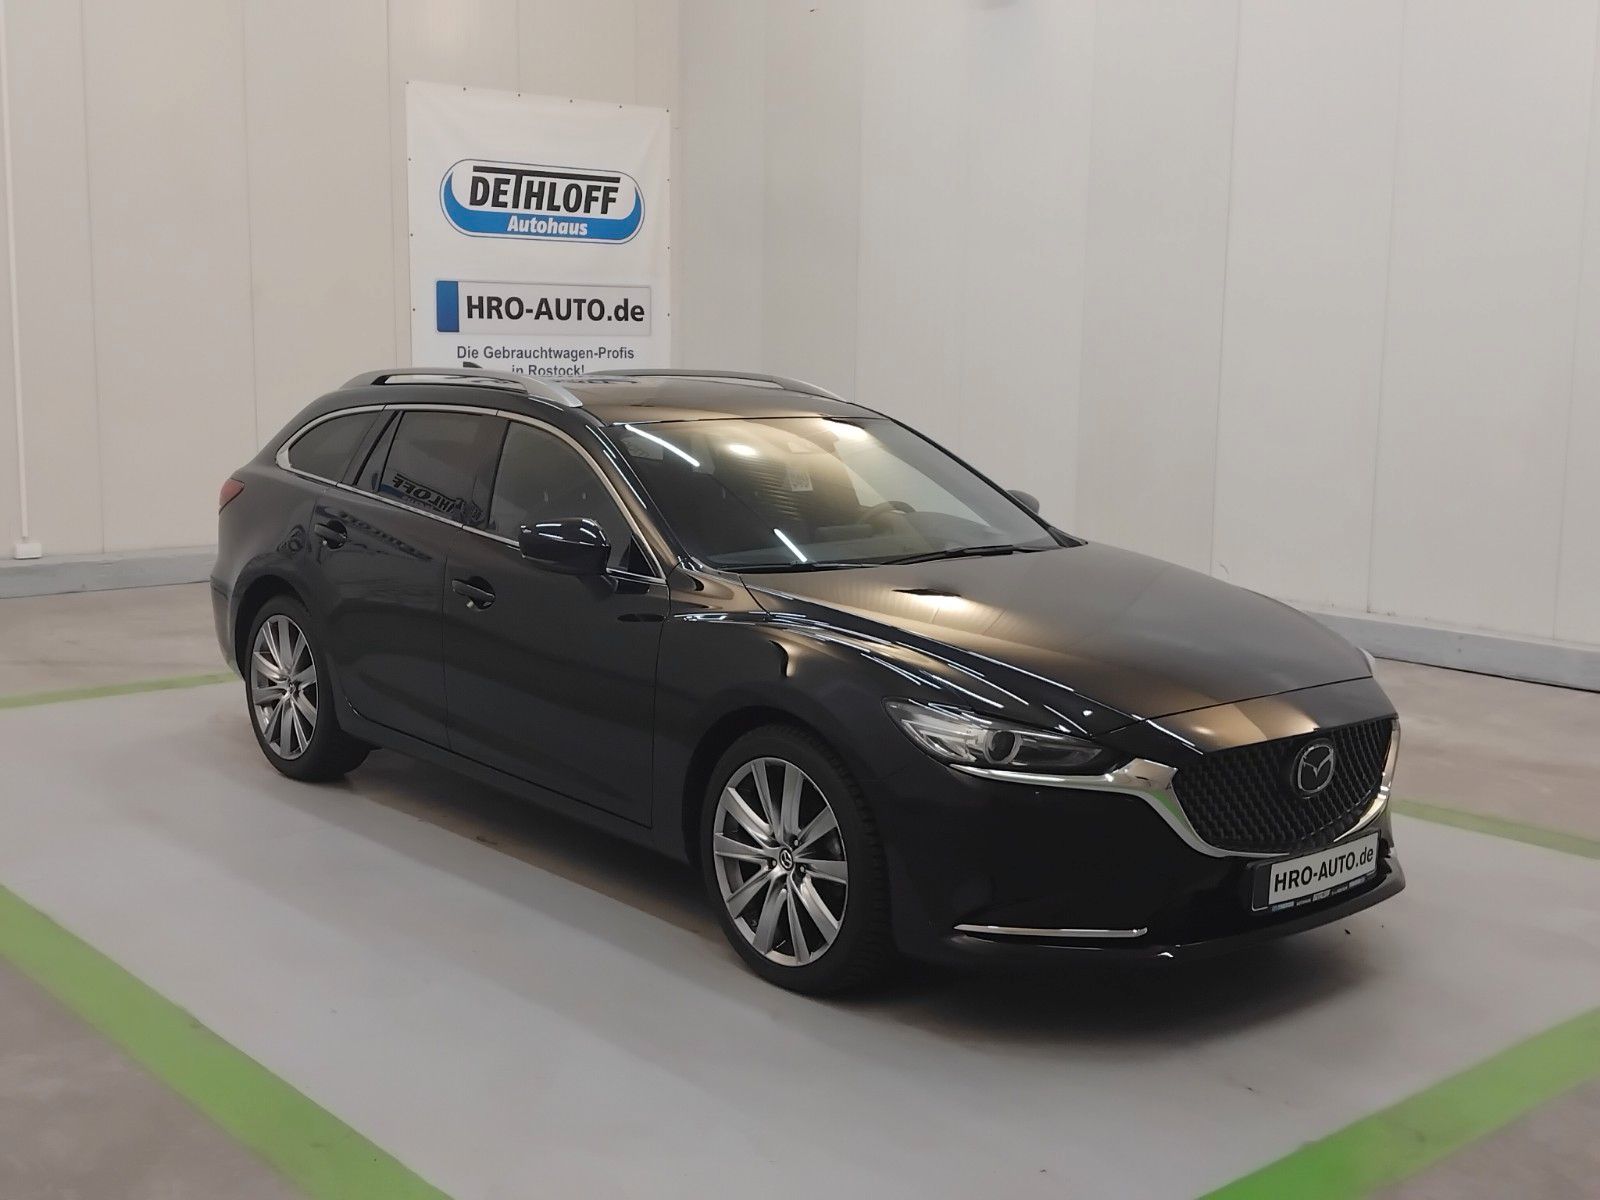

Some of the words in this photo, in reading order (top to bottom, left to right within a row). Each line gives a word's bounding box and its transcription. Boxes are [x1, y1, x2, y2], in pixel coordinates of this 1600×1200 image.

[469, 165, 621, 215] DETHLOFF
[507, 215, 588, 236] Autohaus
[466, 295, 645, 322] HRO-AUTO.de
[457, 346, 479, 359] Die
[483, 346, 635, 362] Gebrauchtwagen-Profis
[512, 364, 524, 375] in
[1274, 846, 1374, 892] HRO-AUTO.de
